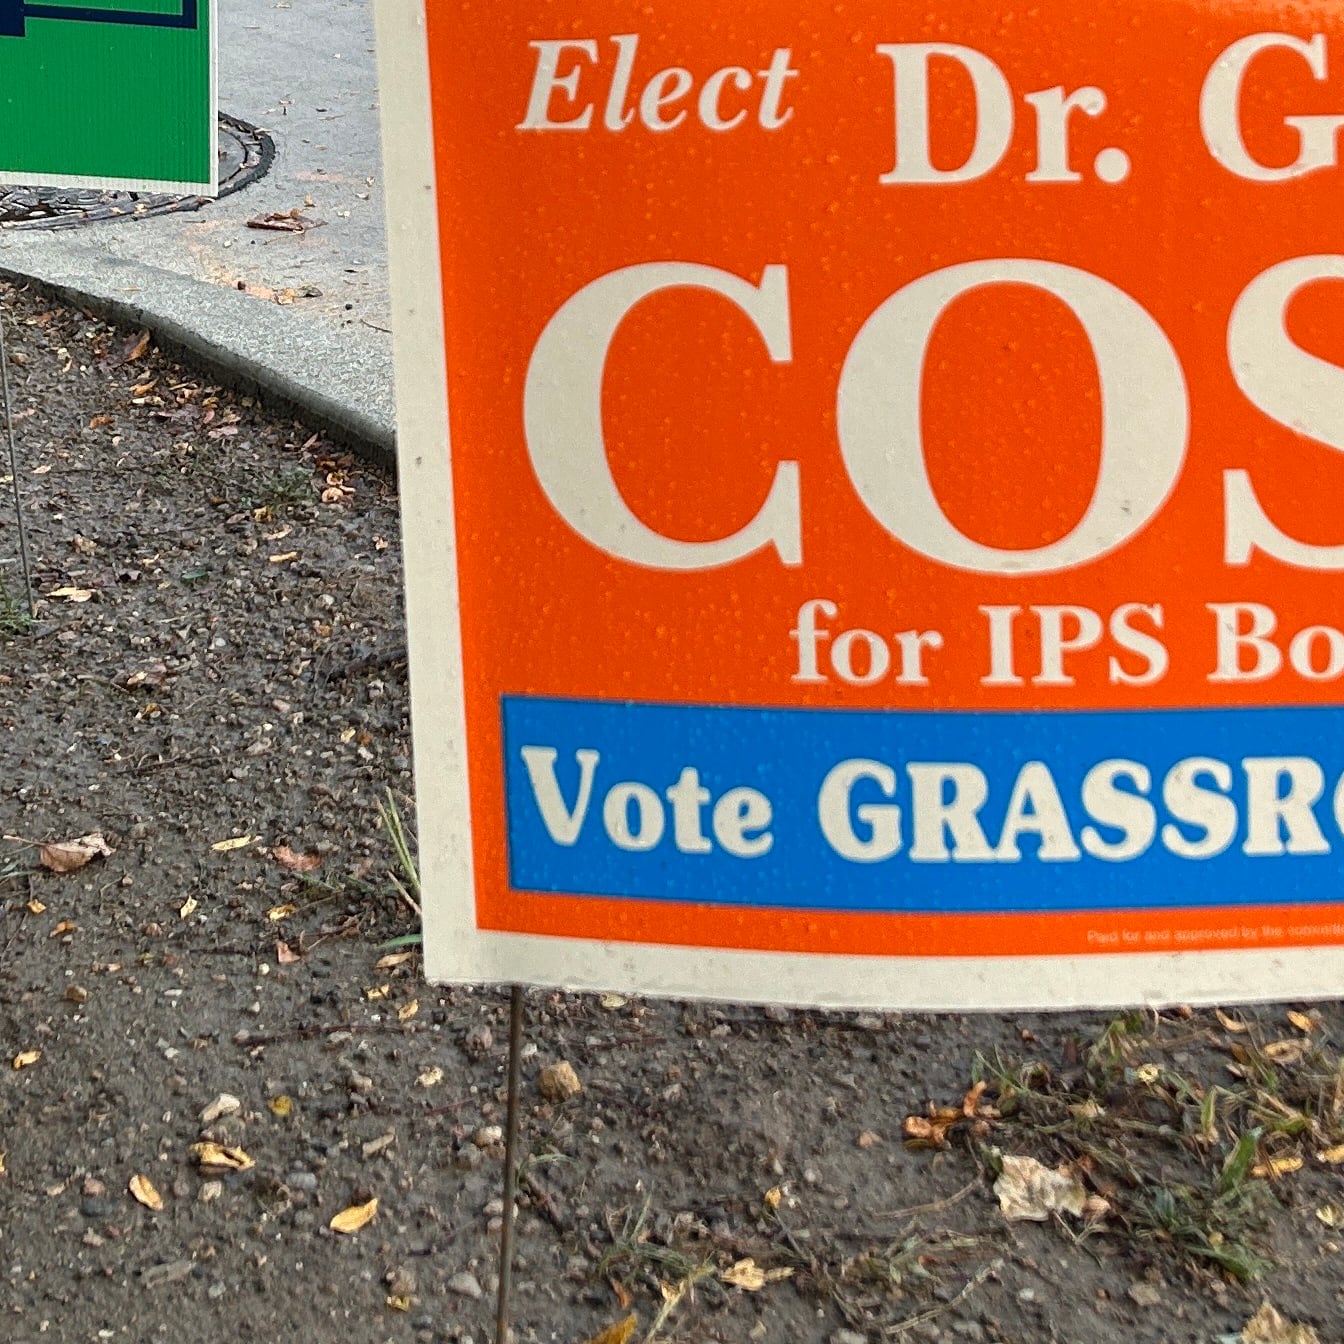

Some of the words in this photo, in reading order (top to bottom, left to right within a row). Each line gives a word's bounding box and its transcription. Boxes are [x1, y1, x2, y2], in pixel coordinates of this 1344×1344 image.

[516, 34, 798, 133] Elect
[876, 43, 1130, 185] Dr.
[788, 600, 944, 685] for
[980, 603, 1168, 685] IPS
[521, 747, 774, 858] Vote
